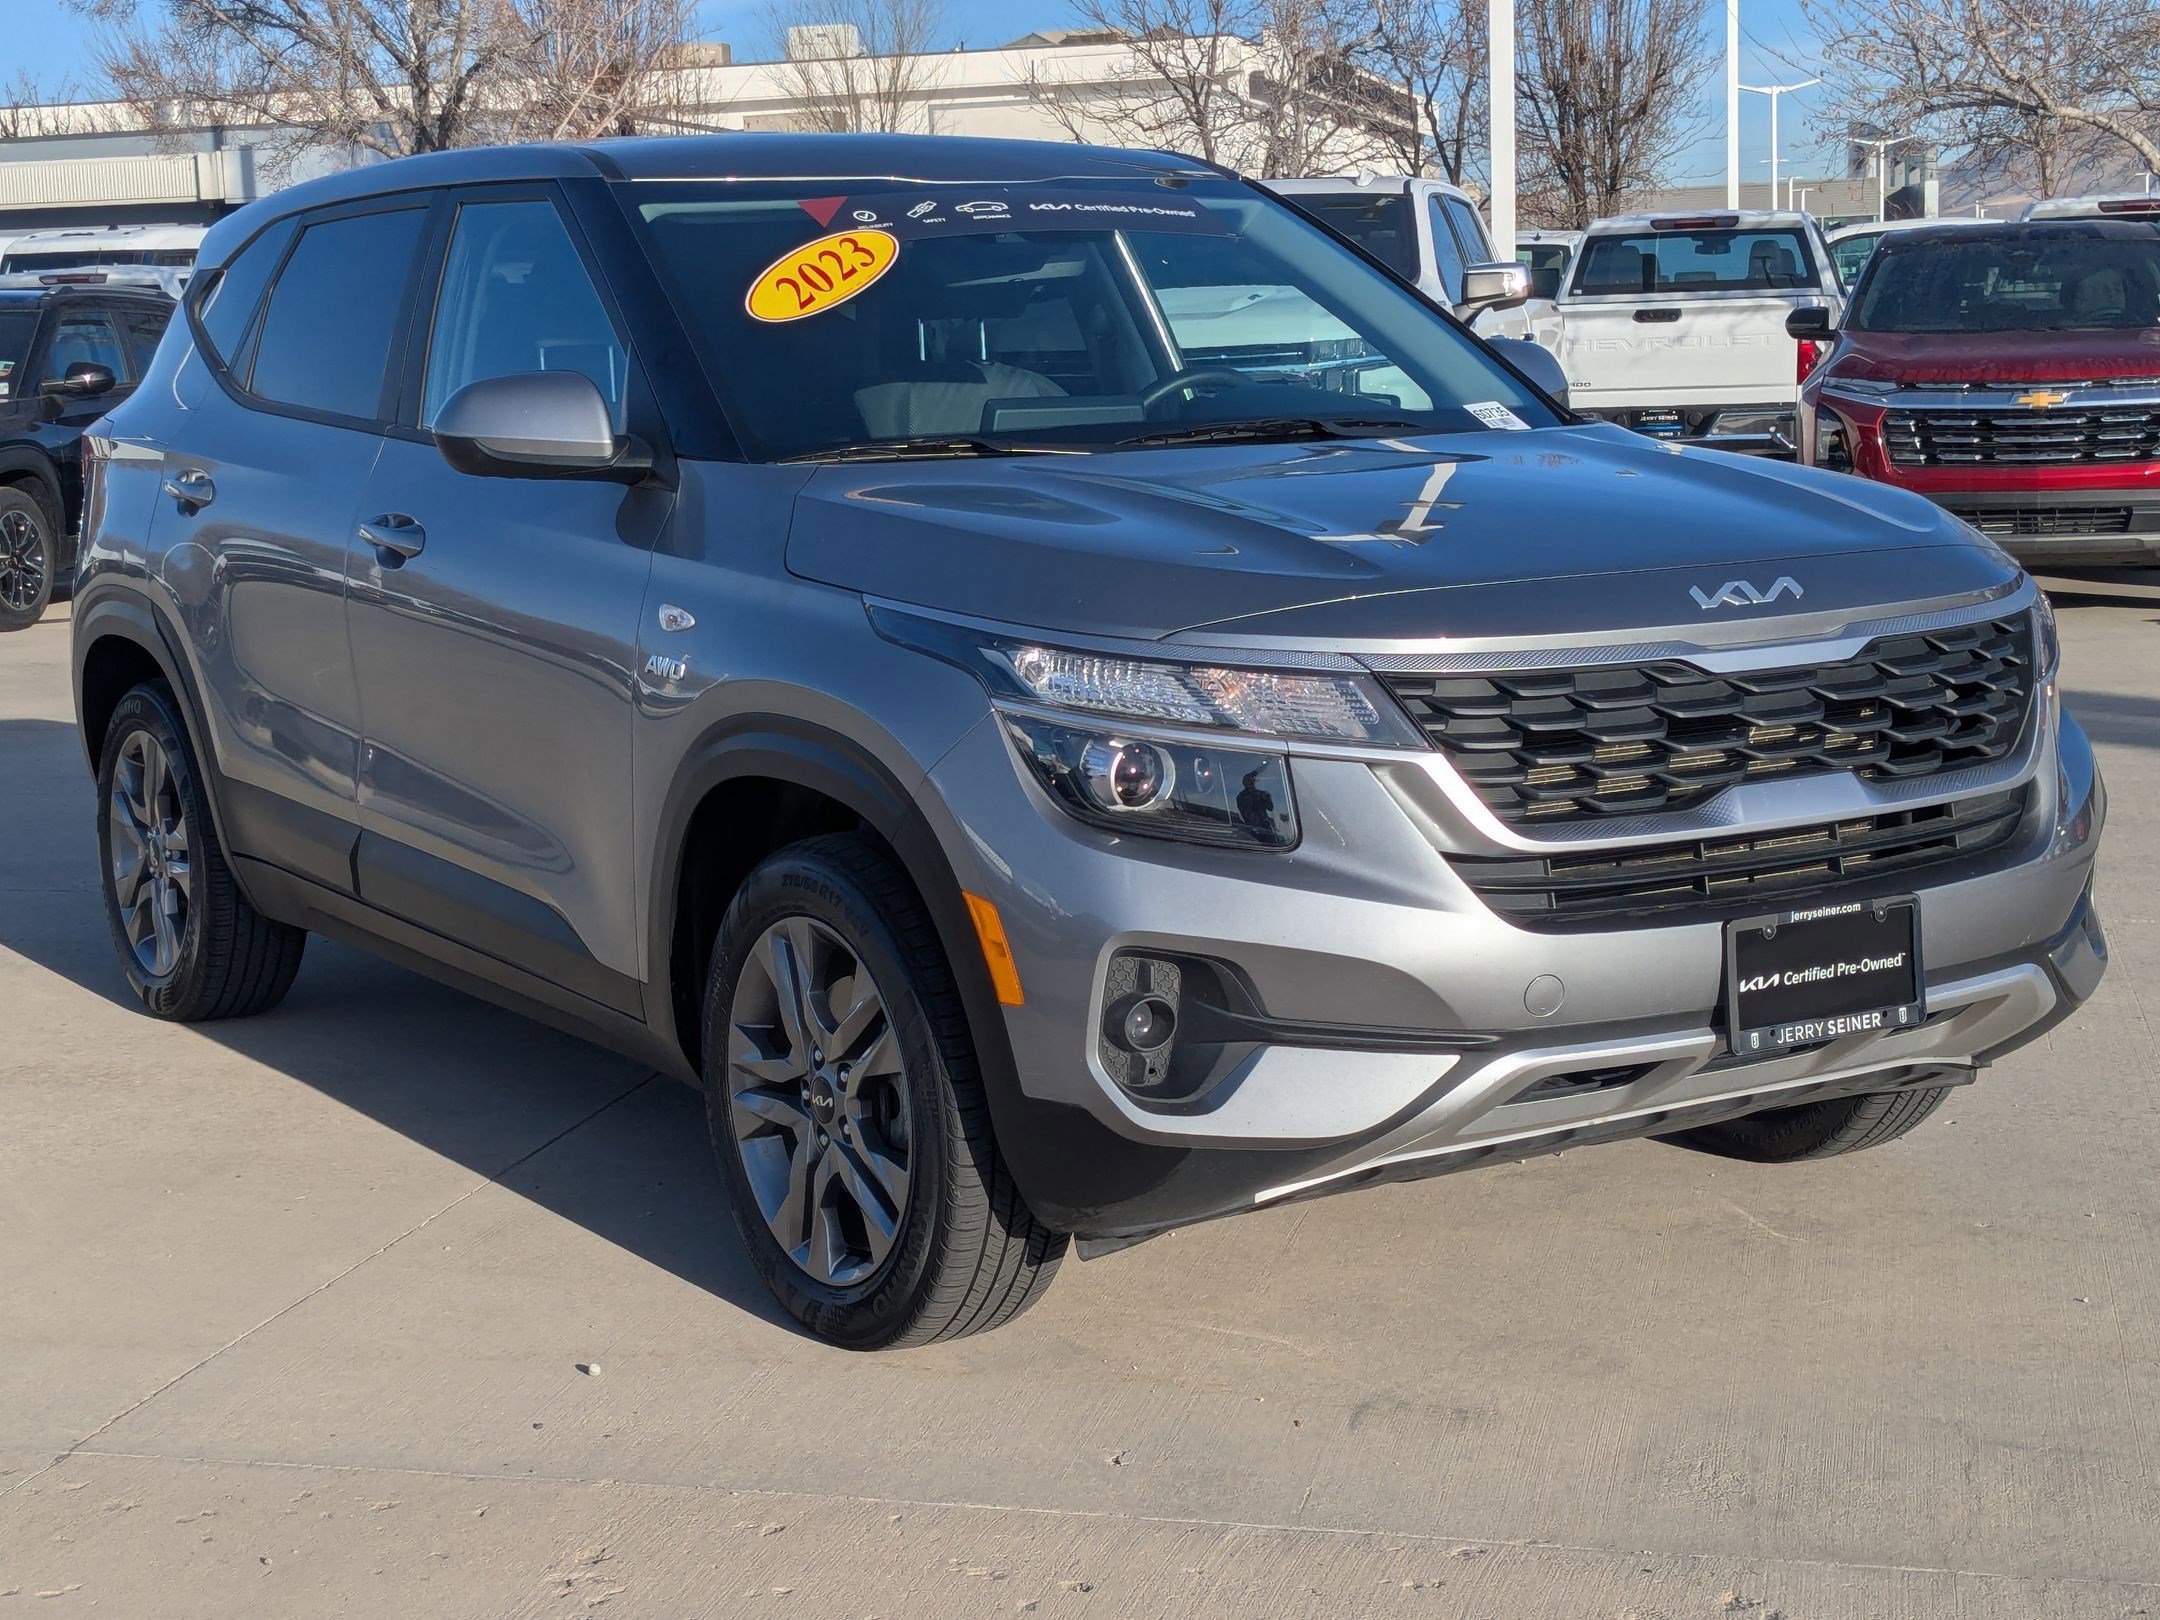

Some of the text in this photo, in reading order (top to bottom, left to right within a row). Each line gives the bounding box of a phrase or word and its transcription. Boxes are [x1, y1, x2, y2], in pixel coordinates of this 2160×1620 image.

[1074, 203, 1129, 213] Certified
[776, 238, 875, 310] 2023
[1566, 334, 1780, 352] HEVROLET
[1473, 407, 1510, 419] 60735
[1688, 576, 1804, 609] KIA
[644, 655, 687, 681] AWD
[1791, 903, 1861, 922] jerryseiner.com
[1739, 973, 1780, 993] KIA
[1783, 964, 1834, 986] Certified
[1777, 1012, 1882, 1044] JERRY SEINER
